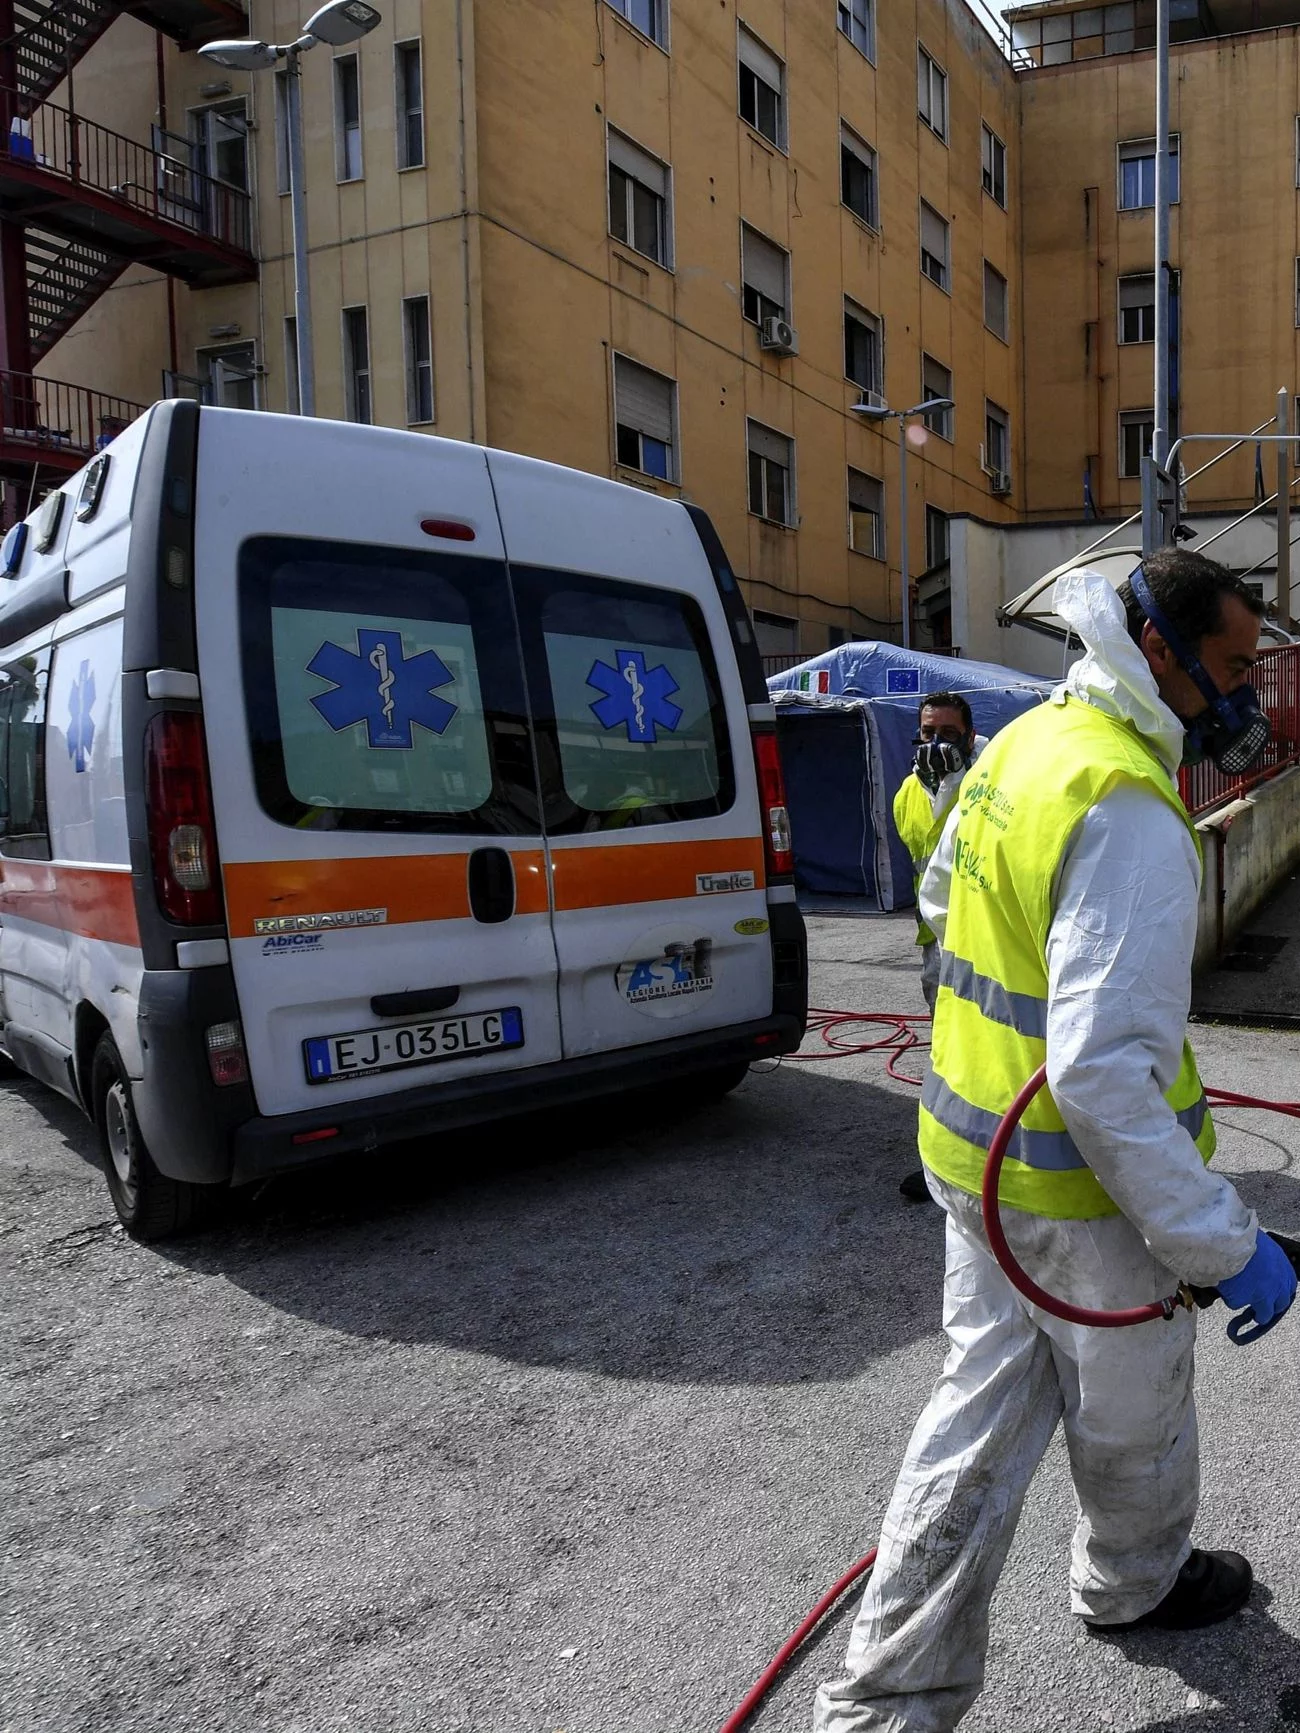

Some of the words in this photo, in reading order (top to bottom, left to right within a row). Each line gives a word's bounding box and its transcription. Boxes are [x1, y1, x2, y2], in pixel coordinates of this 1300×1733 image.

[256, 910, 385, 932] RENAULT
[263, 934, 322, 948] AbiCar
[626, 985, 665, 998] REGIONE
[672, 977, 713, 990] CAMPANIA
